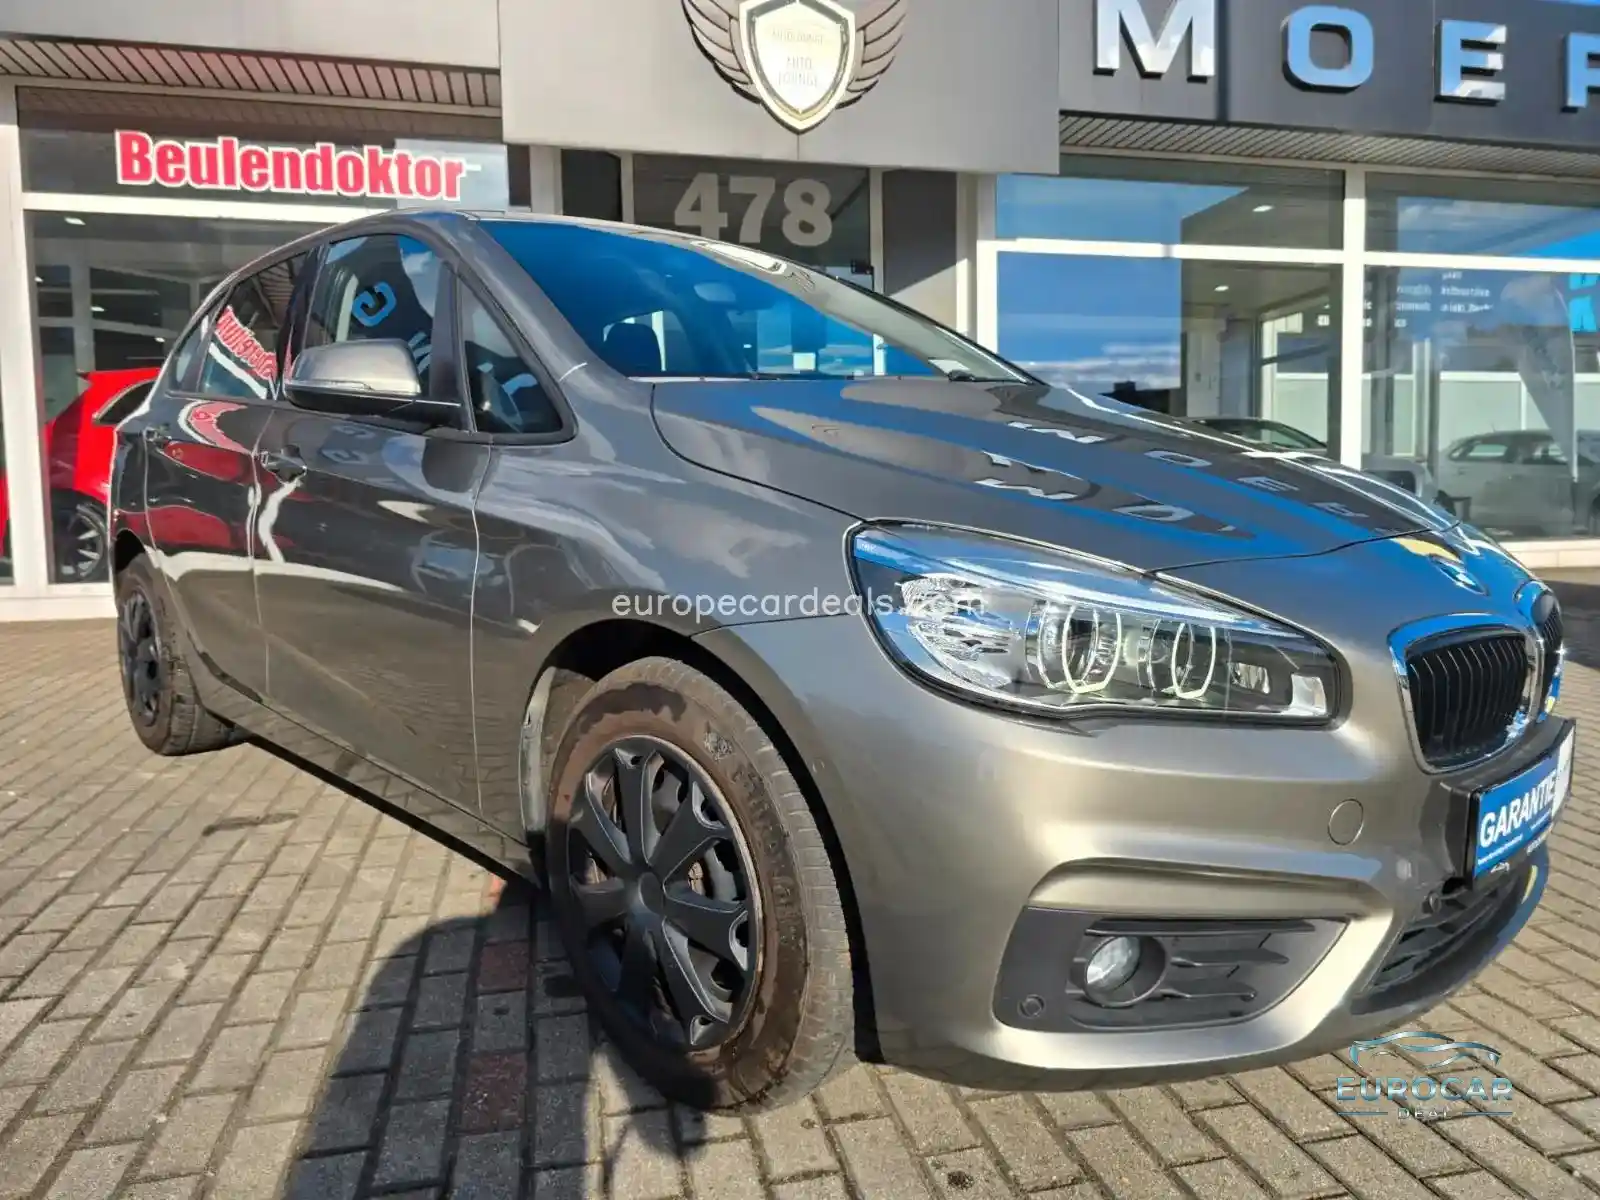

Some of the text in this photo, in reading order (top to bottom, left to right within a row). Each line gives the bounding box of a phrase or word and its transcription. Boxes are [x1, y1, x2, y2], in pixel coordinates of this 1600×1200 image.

[115, 130, 466, 200] Beulendoktor
[674, 172, 832, 246] 478
[1480, 771, 1557, 848] GARANTIE
